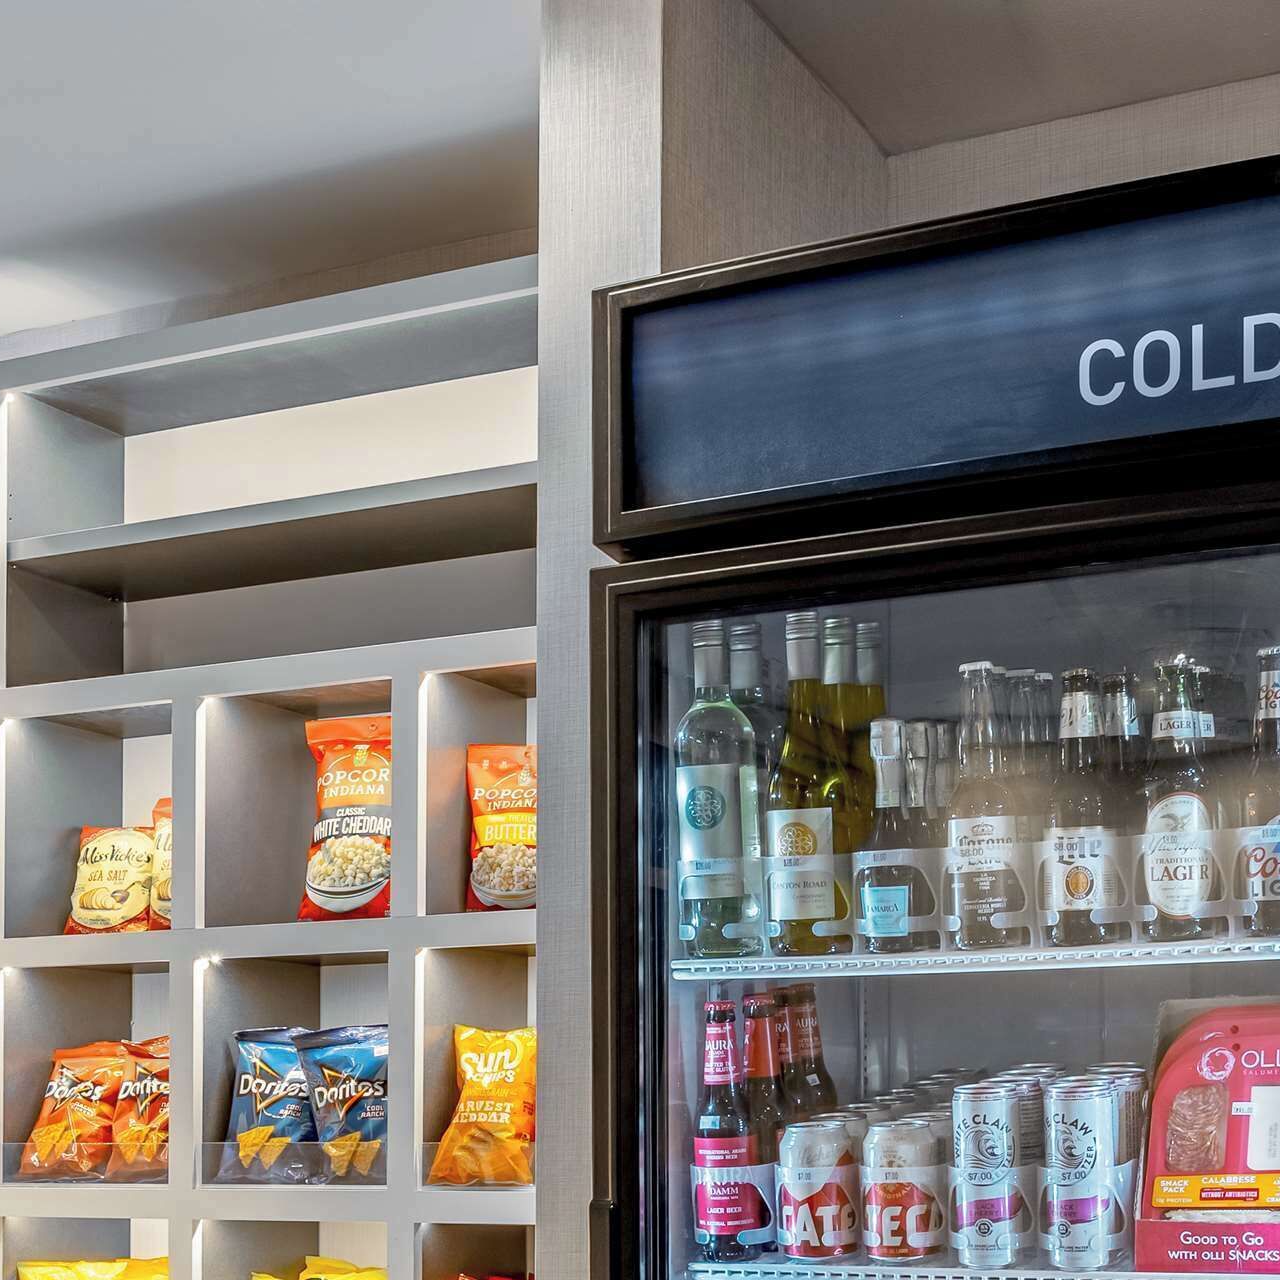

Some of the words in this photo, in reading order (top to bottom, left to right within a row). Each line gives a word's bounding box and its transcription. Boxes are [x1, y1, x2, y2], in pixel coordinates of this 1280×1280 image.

[1159, 721, 1191, 732] LAGER
[324, 784, 385, 799] INDIANA
[336, 807, 366, 817] CLASSIC
[314, 817, 341, 843] WHITE
[342, 817, 392, 836] CHEDDAR
[88, 870, 102, 881] SEA
[107, 870, 128, 880] SALT
[314, 1079, 387, 1108] Doritos
[360, 1110, 385, 1119] RANCH
[1052, 1112, 1092, 1137] CLAW
[968, 1171, 993, 1181] $7.00
[1061, 1171, 1086, 1182] $7.00
[1202, 1176, 1256, 1184] CALABRESE
[1222, 1236, 1237, 1245] TO
[1242, 1232, 1264, 1246] GO
[1168, 1250, 1197, 1260] WITH
[1202, 1251, 1225, 1260] OLLI
[1229, 1250, 1280, 1262] SNACKS
